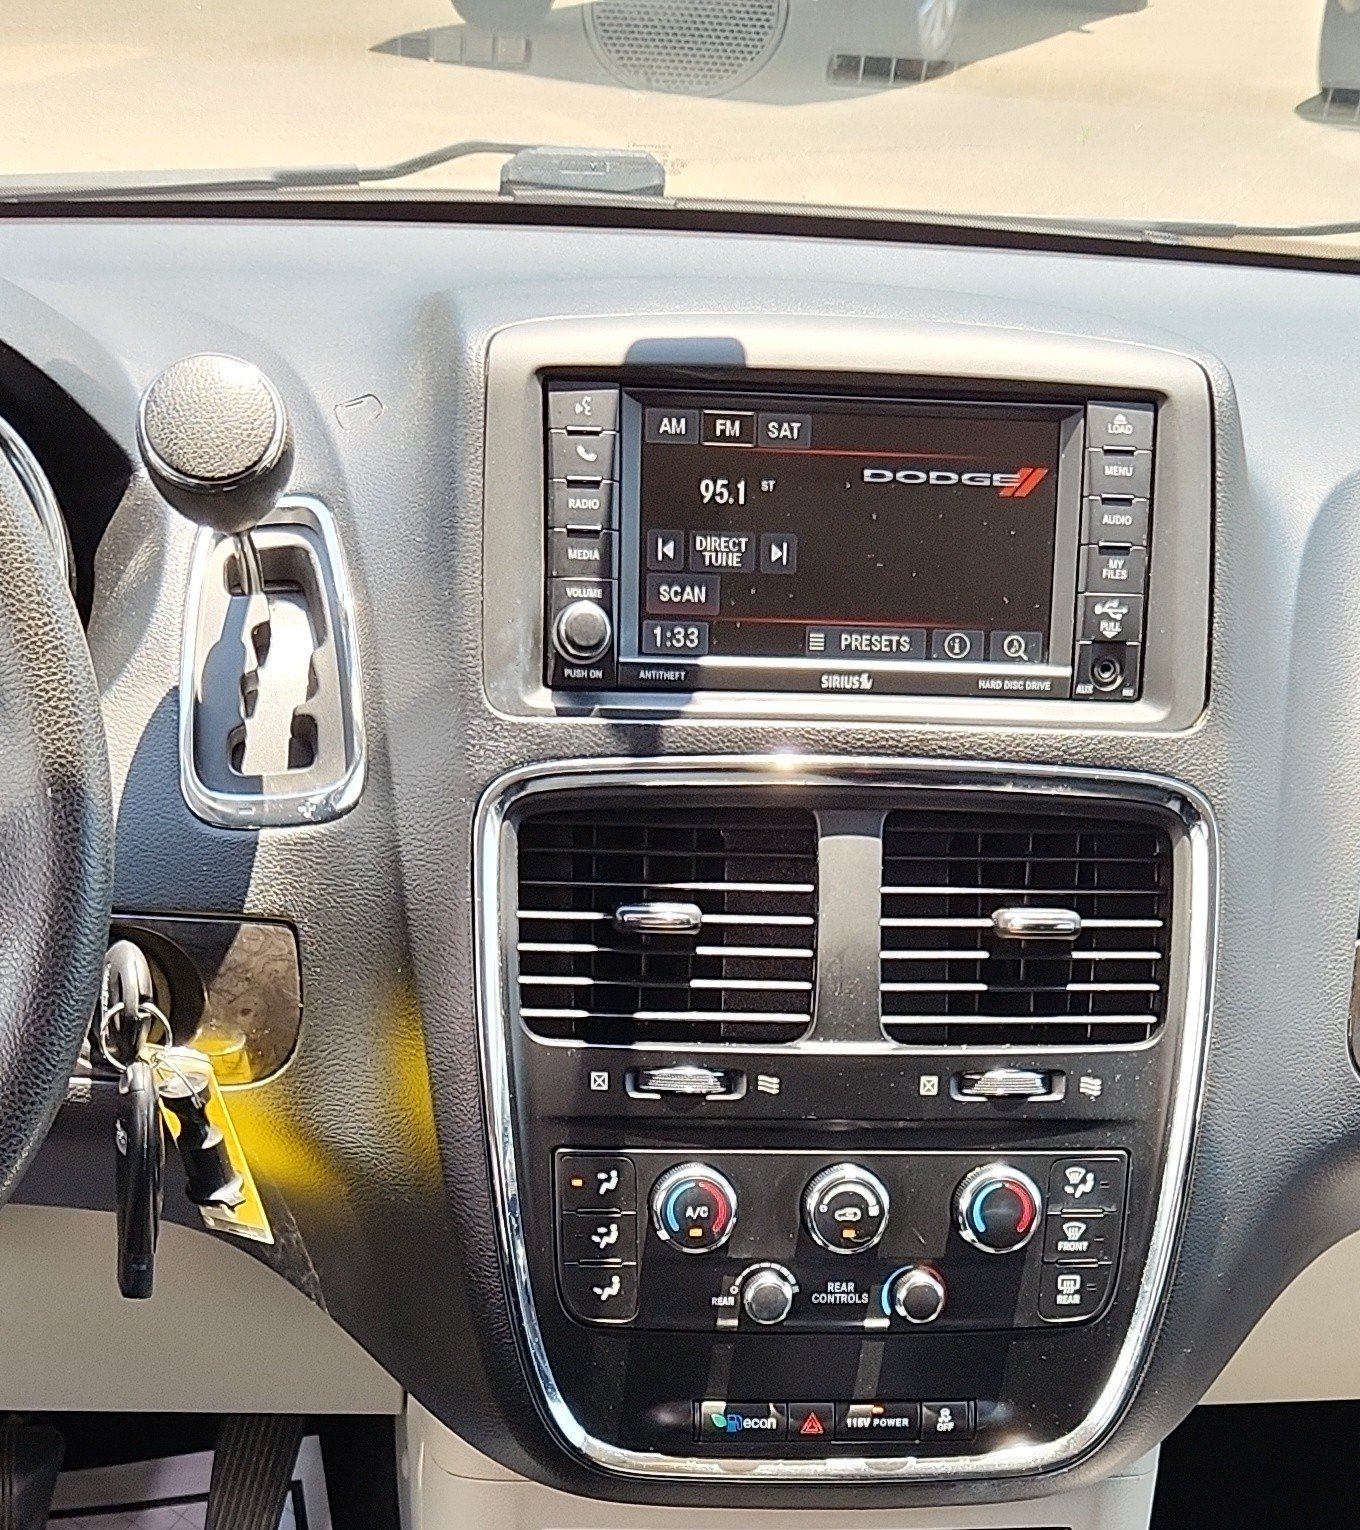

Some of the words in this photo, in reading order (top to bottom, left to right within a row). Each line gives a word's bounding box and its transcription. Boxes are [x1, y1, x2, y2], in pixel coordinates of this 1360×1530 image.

[658, 417, 686, 436] AM
[714, 419, 742, 438] FM
[767, 422, 801, 440] SAT
[1107, 424, 1134, 436] LOAD
[863, 468, 1022, 488] DODGE
[1104, 465, 1134, 478] MENU
[699, 478, 746, 506] 95.1
[760, 480, 776, 493] ST
[568, 498, 600, 511] RADIO
[1102, 514, 1133, 527] AUDIO
[695, 536, 749, 553] DIRECT
[567, 547, 601, 562] MEDIA
[702, 551, 743, 568] TUNE
[1108, 558, 1125, 569] MY
[1102, 568, 1128, 581] FILES
[565, 586, 603, 600] VOLUME
[659, 585, 707, 604] SCAN
[1100, 621, 1122, 632] PULL
[653, 626, 700, 649] 1:33
[840, 634, 911, 654] PRESETS
[564, 668, 588, 682] PUSH
[589, 668, 603, 682] ON
[639, 668, 687, 683] ANTITHEFT
[821, 674, 862, 691] SIRIUS
[978, 678, 1001, 691] HARD
[1003, 679, 1023, 692] DISC
[1025, 680, 1053, 693] DRIVE
[1076, 683, 1094, 695] AUX
[685, 1205, 709, 1220] A/C
[1057, 1241, 1089, 1252] FRONT
[827, 1282, 855, 1293] REAR
[711, 1297, 735, 1306] REAR
[811, 1292, 869, 1304] CONTROLS
[1056, 1294, 1081, 1305] REAR
[743, 1416, 777, 1430] econ
[873, 1418, 910, 1428] POWER
[937, 1421, 955, 1432] OFF
